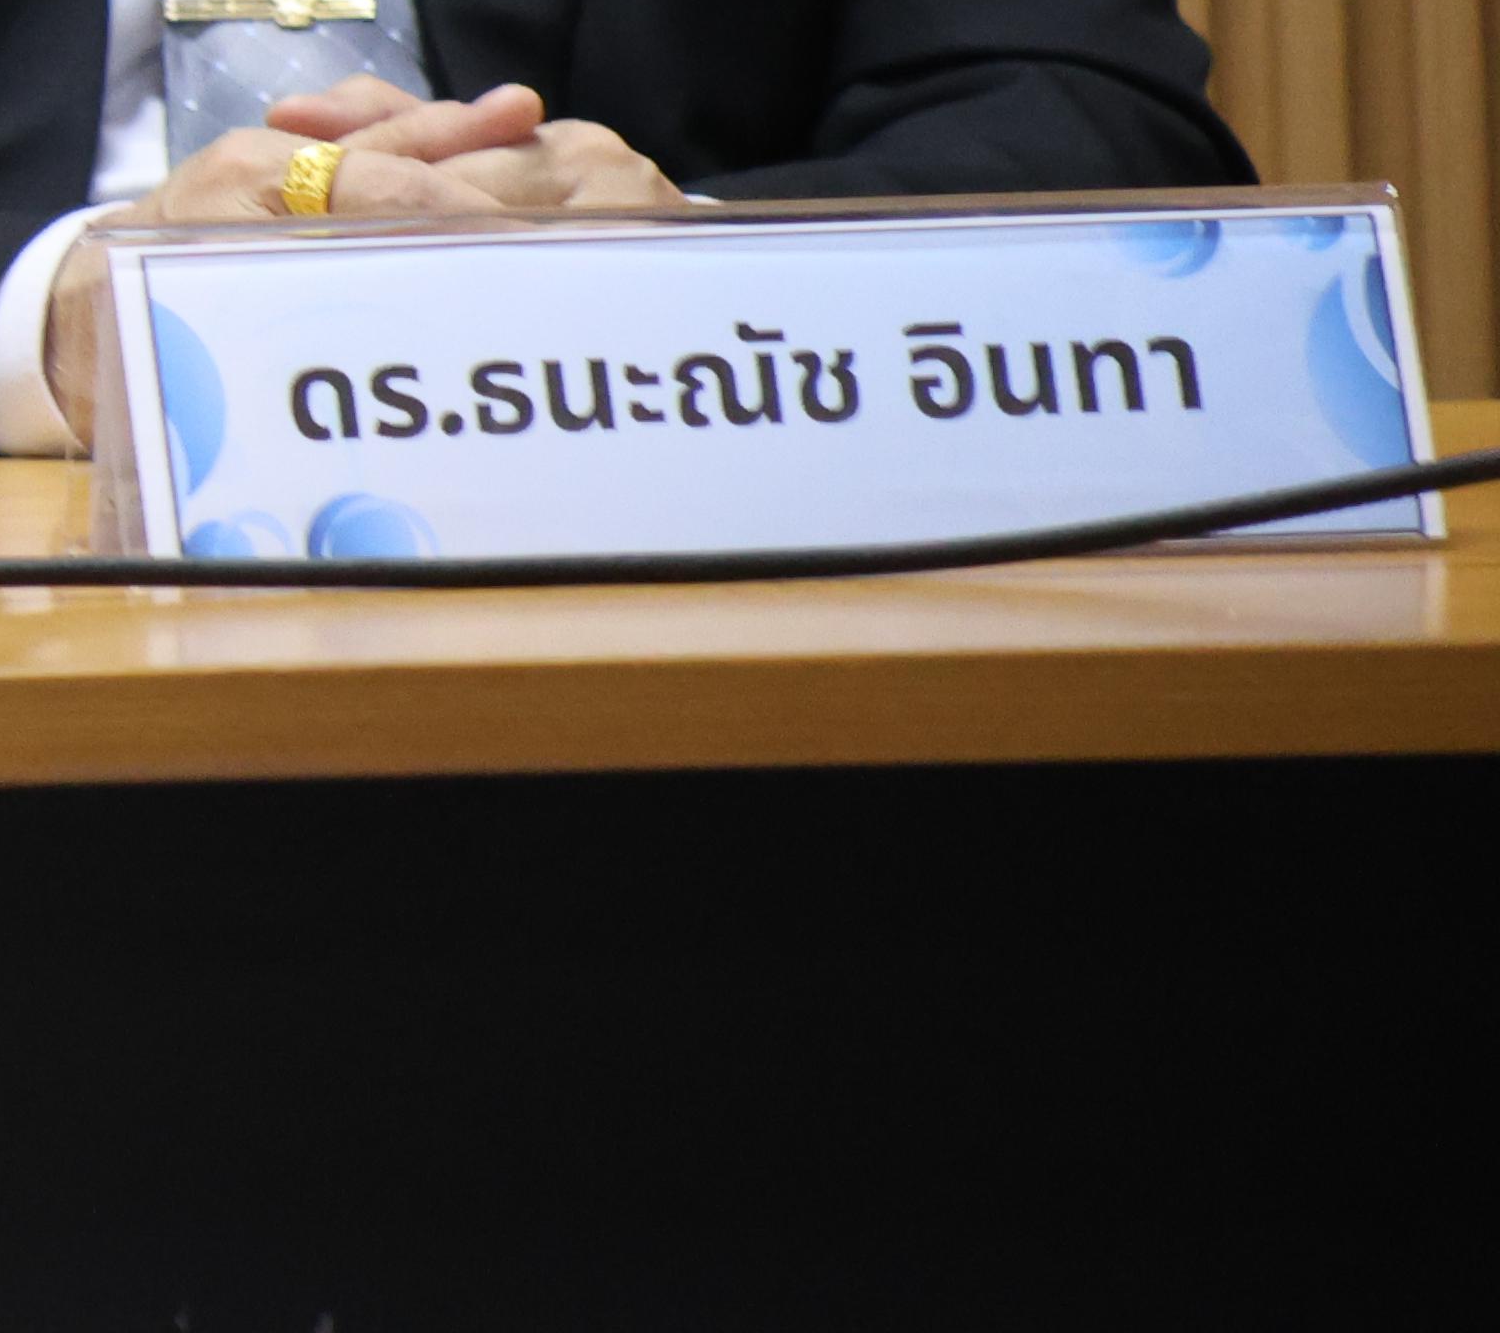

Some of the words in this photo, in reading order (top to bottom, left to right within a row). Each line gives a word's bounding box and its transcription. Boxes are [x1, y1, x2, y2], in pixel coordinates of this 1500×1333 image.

[290, 321, 861, 441] ดร.ธนะณัช
[901, 321, 1203, 420] อินทา
